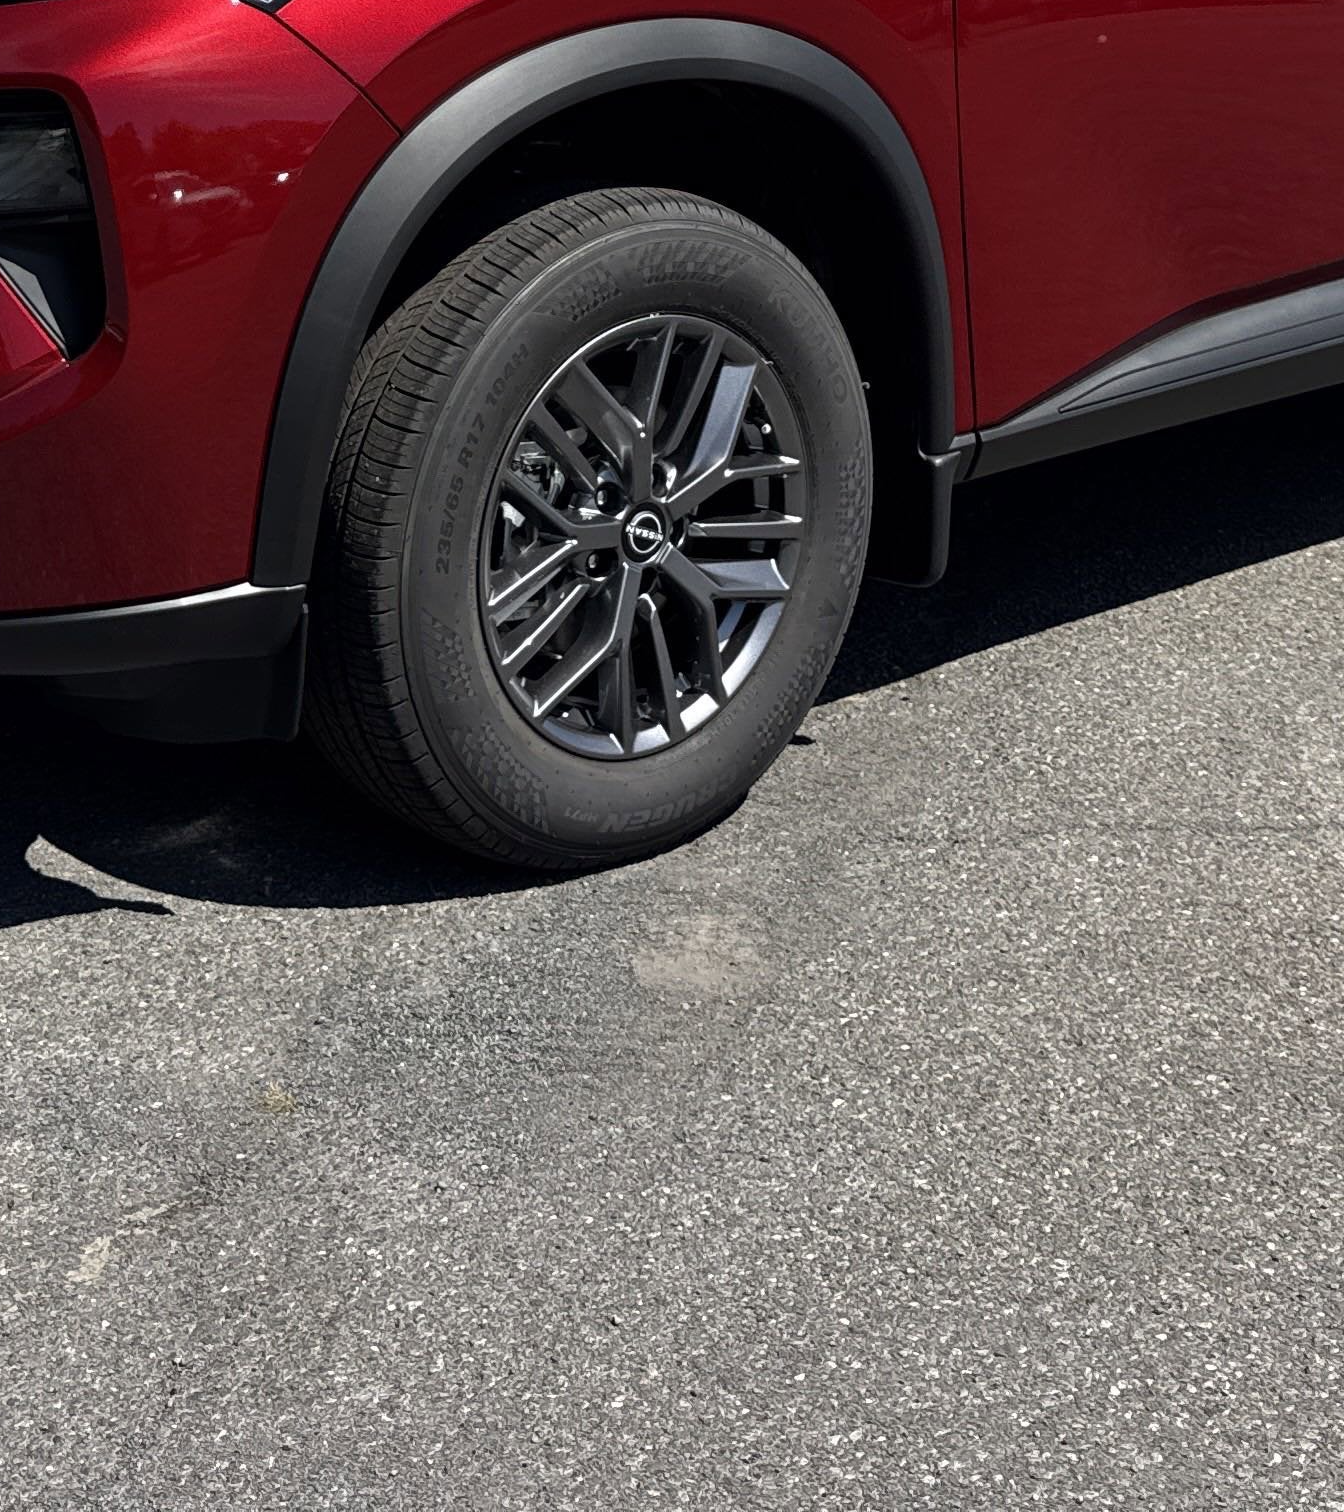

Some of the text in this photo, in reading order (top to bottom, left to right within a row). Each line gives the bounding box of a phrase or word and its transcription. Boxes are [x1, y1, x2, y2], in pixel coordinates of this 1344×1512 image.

[435, 343, 529, 575] 235/65 R17 104H
[626, 523, 664, 541] NISSAN
